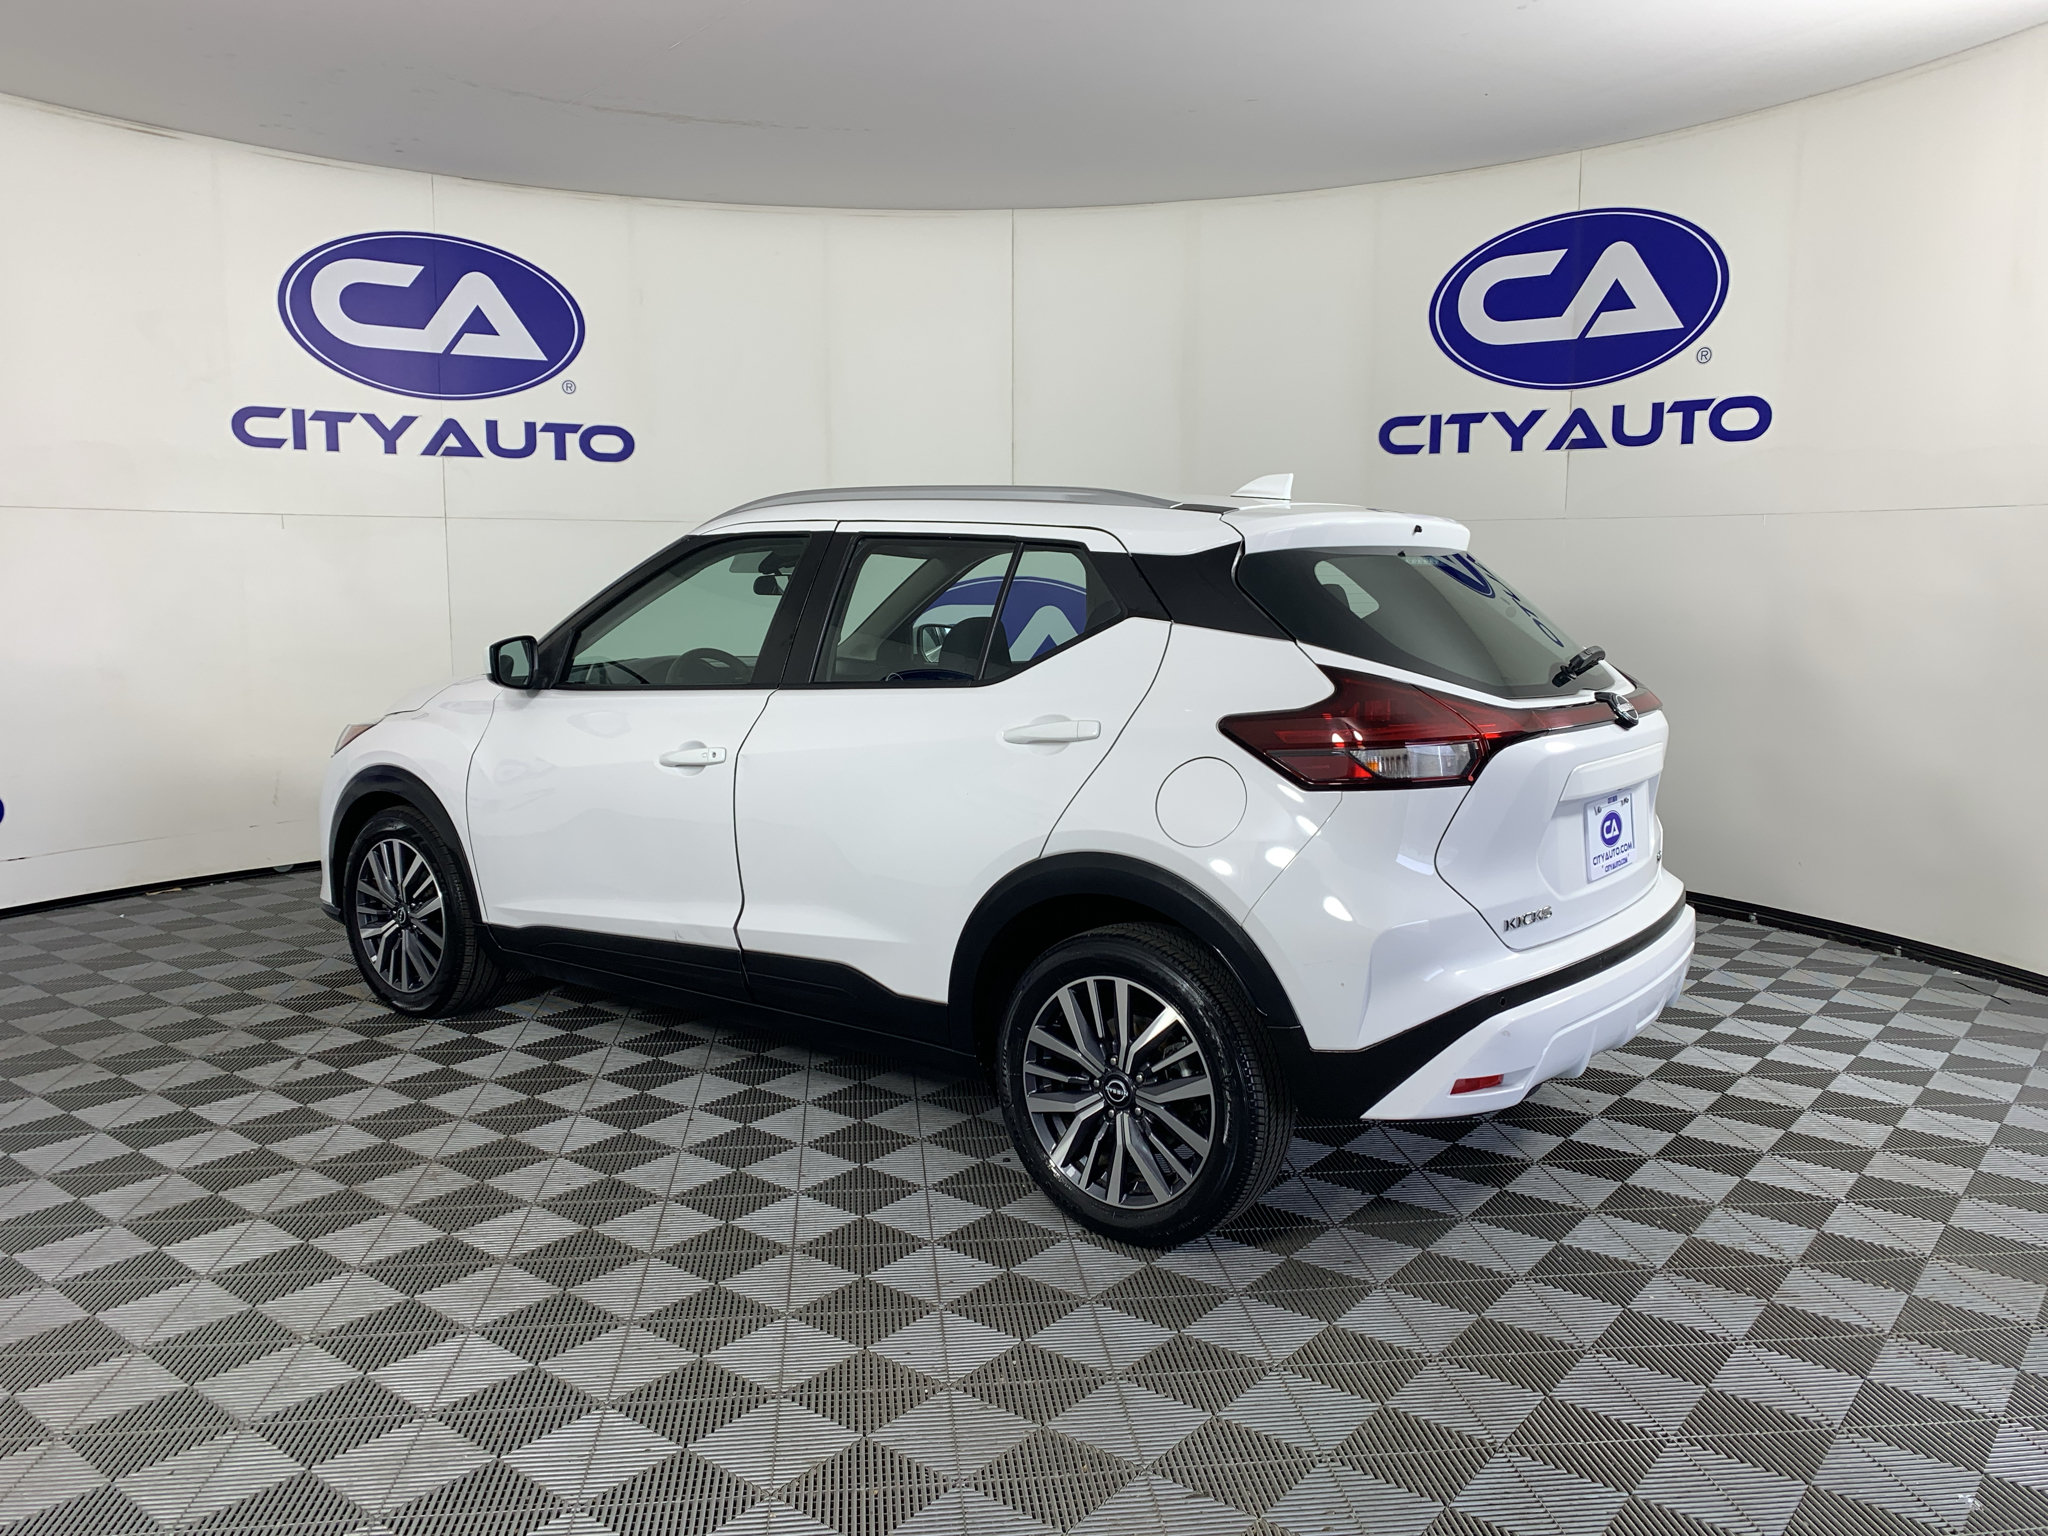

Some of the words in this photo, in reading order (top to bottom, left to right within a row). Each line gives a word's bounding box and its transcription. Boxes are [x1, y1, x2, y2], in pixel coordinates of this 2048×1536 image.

[310, 257, 549, 361] CA
[1458, 240, 1684, 345] CA
[231, 405, 420, 455] CITY
[419, 417, 636, 463] AUTO
[1378, 408, 1548, 454] CITY
[1545, 395, 1773, 451] AUTO
[1503, 905, 1553, 932] KICKS
